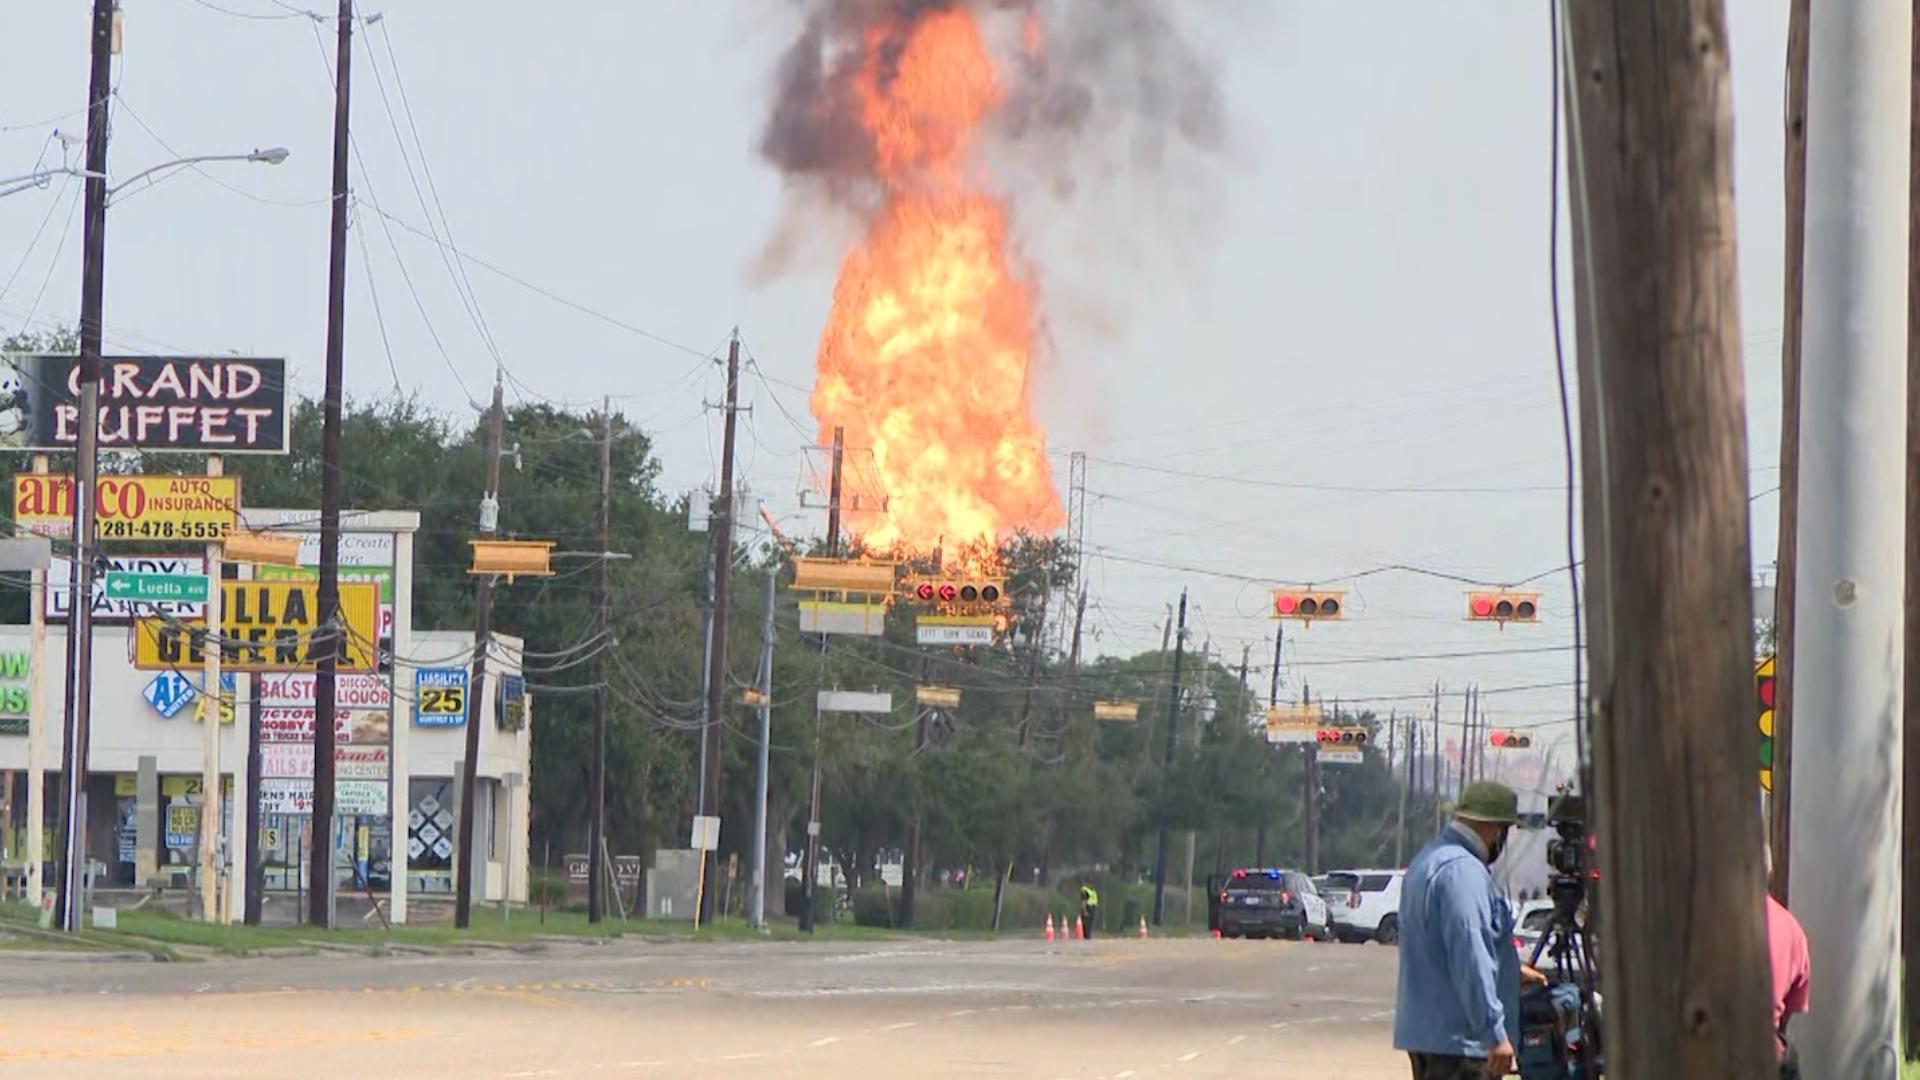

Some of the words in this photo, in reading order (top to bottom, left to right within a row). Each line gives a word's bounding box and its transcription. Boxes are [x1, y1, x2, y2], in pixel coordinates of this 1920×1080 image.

[55, 404, 272, 443] BUFFET
[170, 480, 210, 493] AUTO
[149, 497, 232, 511] INSURANCE
[104, 521, 232, 537] 281-478-5555
[138, 578, 182, 594] Luella
[54, 591, 196, 613] LATHER
[221, 587, 308, 625] LLA
[158, 627, 355, 665] GENERL
[418, 672, 464, 685] LIABILITY
[164, 688, 194, 718] UNITED
[337, 690, 389, 704] LIQUOR
[422, 689, 462, 713] 25
[262, 710, 314, 719] ICTOR
[265, 758, 297, 775] AILS
